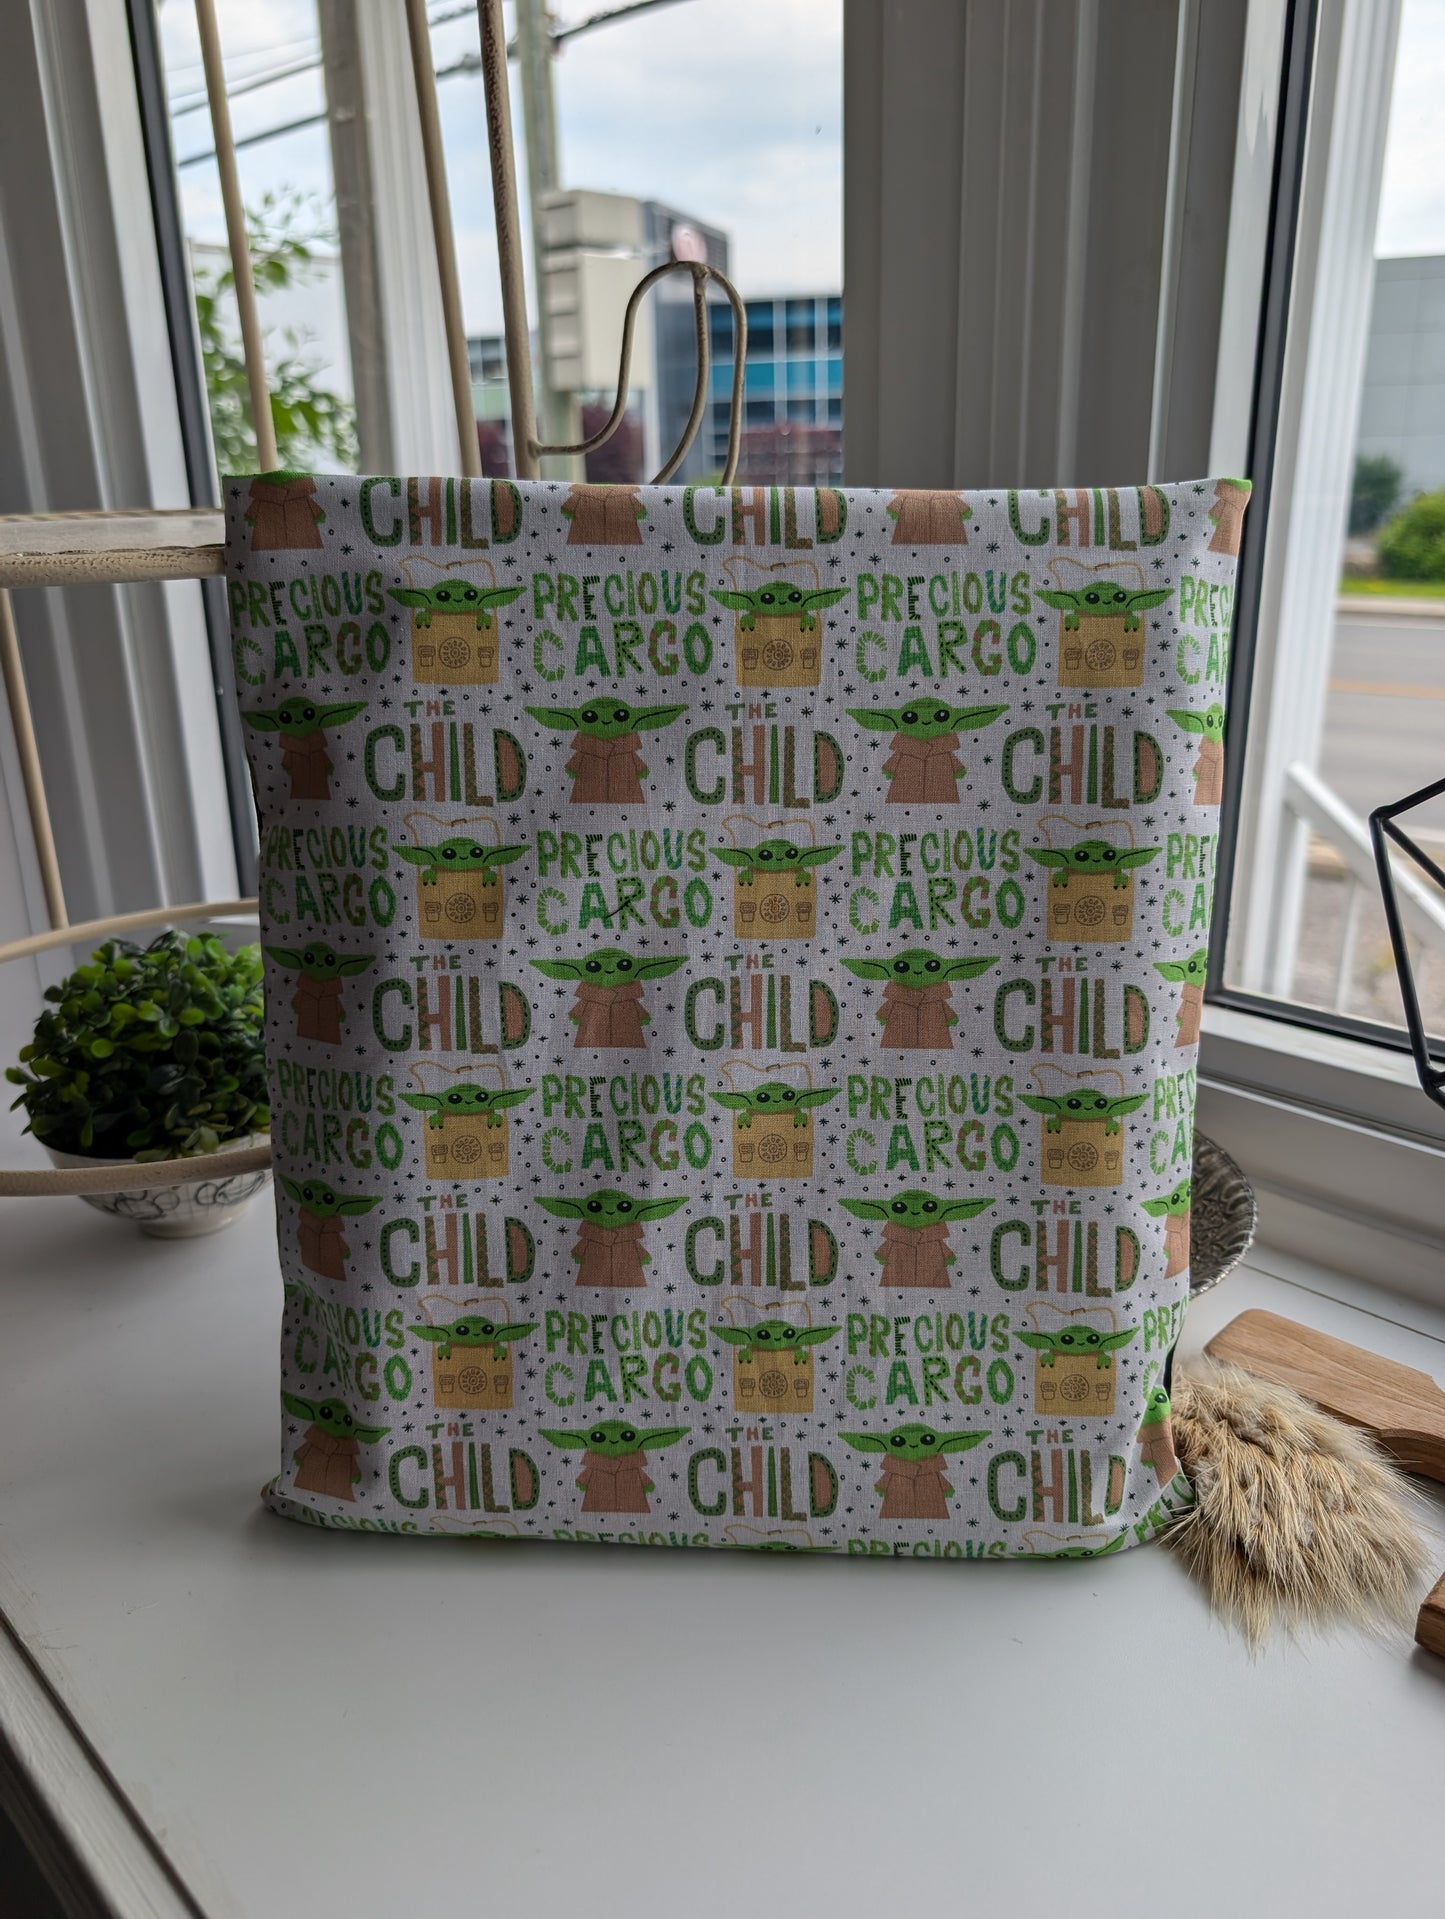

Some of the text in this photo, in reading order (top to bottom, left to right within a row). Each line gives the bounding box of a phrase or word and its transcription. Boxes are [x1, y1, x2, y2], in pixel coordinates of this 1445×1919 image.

[360, 477, 523, 550] CHILD
[683, 486, 848, 550] CHILD
[1008, 486, 1170, 551] CHILD
[230, 569, 385, 628] PRECIOUS
[532, 570, 707, 622] PRECIOUS
[856, 570, 1031, 622] PRECIOUS
[236, 621, 391, 686] CARGO
[532, 620, 714, 682] CARGO
[856, 619, 1036, 683] CARGO
[404, 700, 455, 718] THE
[725, 702, 776, 719] THE
[1046, 703, 1097, 720] THE
[364, 721, 527, 807] CHILD
[685, 724, 845, 809] CHILD
[1001, 724, 1164, 810] CHILD
[263, 824, 389, 871] PRECIOUS
[537, 828, 706, 879] PRECIOUS
[850, 827, 1022, 878] PRECIOUS
[264, 873, 397, 928] CARGO
[536, 876, 713, 936] CARGO
[849, 876, 1025, 935] CARGO
[409, 954, 461, 972] THE
[724, 953, 774, 971] THE
[1035, 956, 1087, 973] THE
[373, 975, 532, 1054] CHILD
[685, 974, 839, 1054] CHILD
[994, 977, 1150, 1059] CHILD
[277, 1058, 396, 1116] PRECIOUS
[542, 1072, 706, 1119] PRECIOUS
[847, 1072, 1014, 1120] PRECIOUS
[281, 1110, 404, 1171] CARGO
[541, 1119, 712, 1175] CARGO
[846, 1119, 1021, 1176] CARGO
[417, 1193, 468, 1210] THE
[724, 1193, 773, 1210] THE
[1031, 1199, 1081, 1216] THE
[380, 1213, 536, 1288] CHILD
[685, 1213, 839, 1291] CHILD
[990, 1218, 1140, 1297] CHILD
[545, 1308, 708, 1356] PRECIOUS
[846, 1311, 1011, 1357] PRECIOUS
[544, 1354, 714, 1408] CARGO
[846, 1356, 1014, 1411] CARGO
[426, 1422, 475, 1439] THE
[725, 1425, 774, 1442] THE
[1025, 1428, 1074, 1445] THE
[389, 1442, 540, 1514] CHILD
[688, 1446, 839, 1521] CHILD
[987, 1449, 1127, 1526] CHILD
